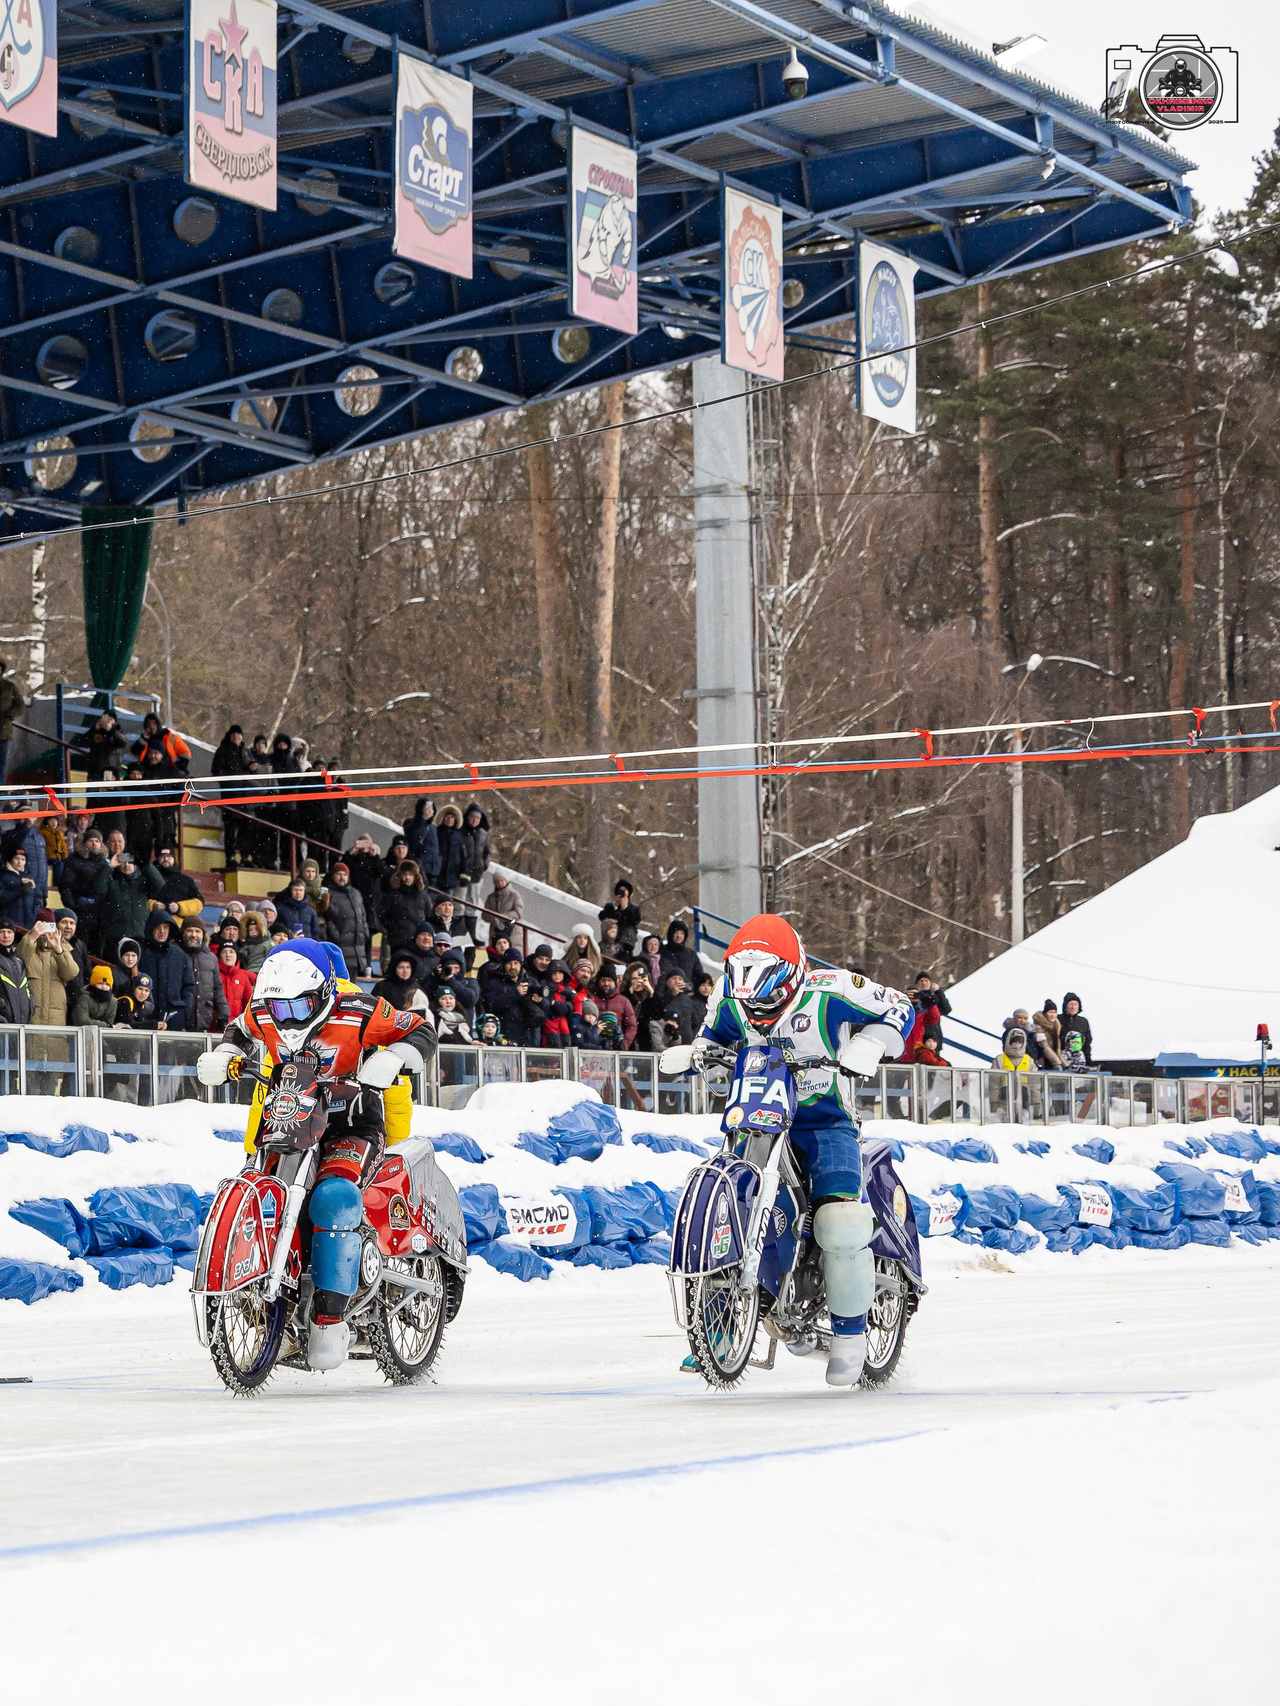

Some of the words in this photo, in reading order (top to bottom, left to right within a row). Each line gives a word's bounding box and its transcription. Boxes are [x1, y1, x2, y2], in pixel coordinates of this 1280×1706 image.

[195, 121, 273, 183] СВЕРДЛОВСК
[408, 144, 463, 202] Старт
[1230, 1067, 1258, 1077] НАС
[510, 1205, 569, 1224] ФМСМО
